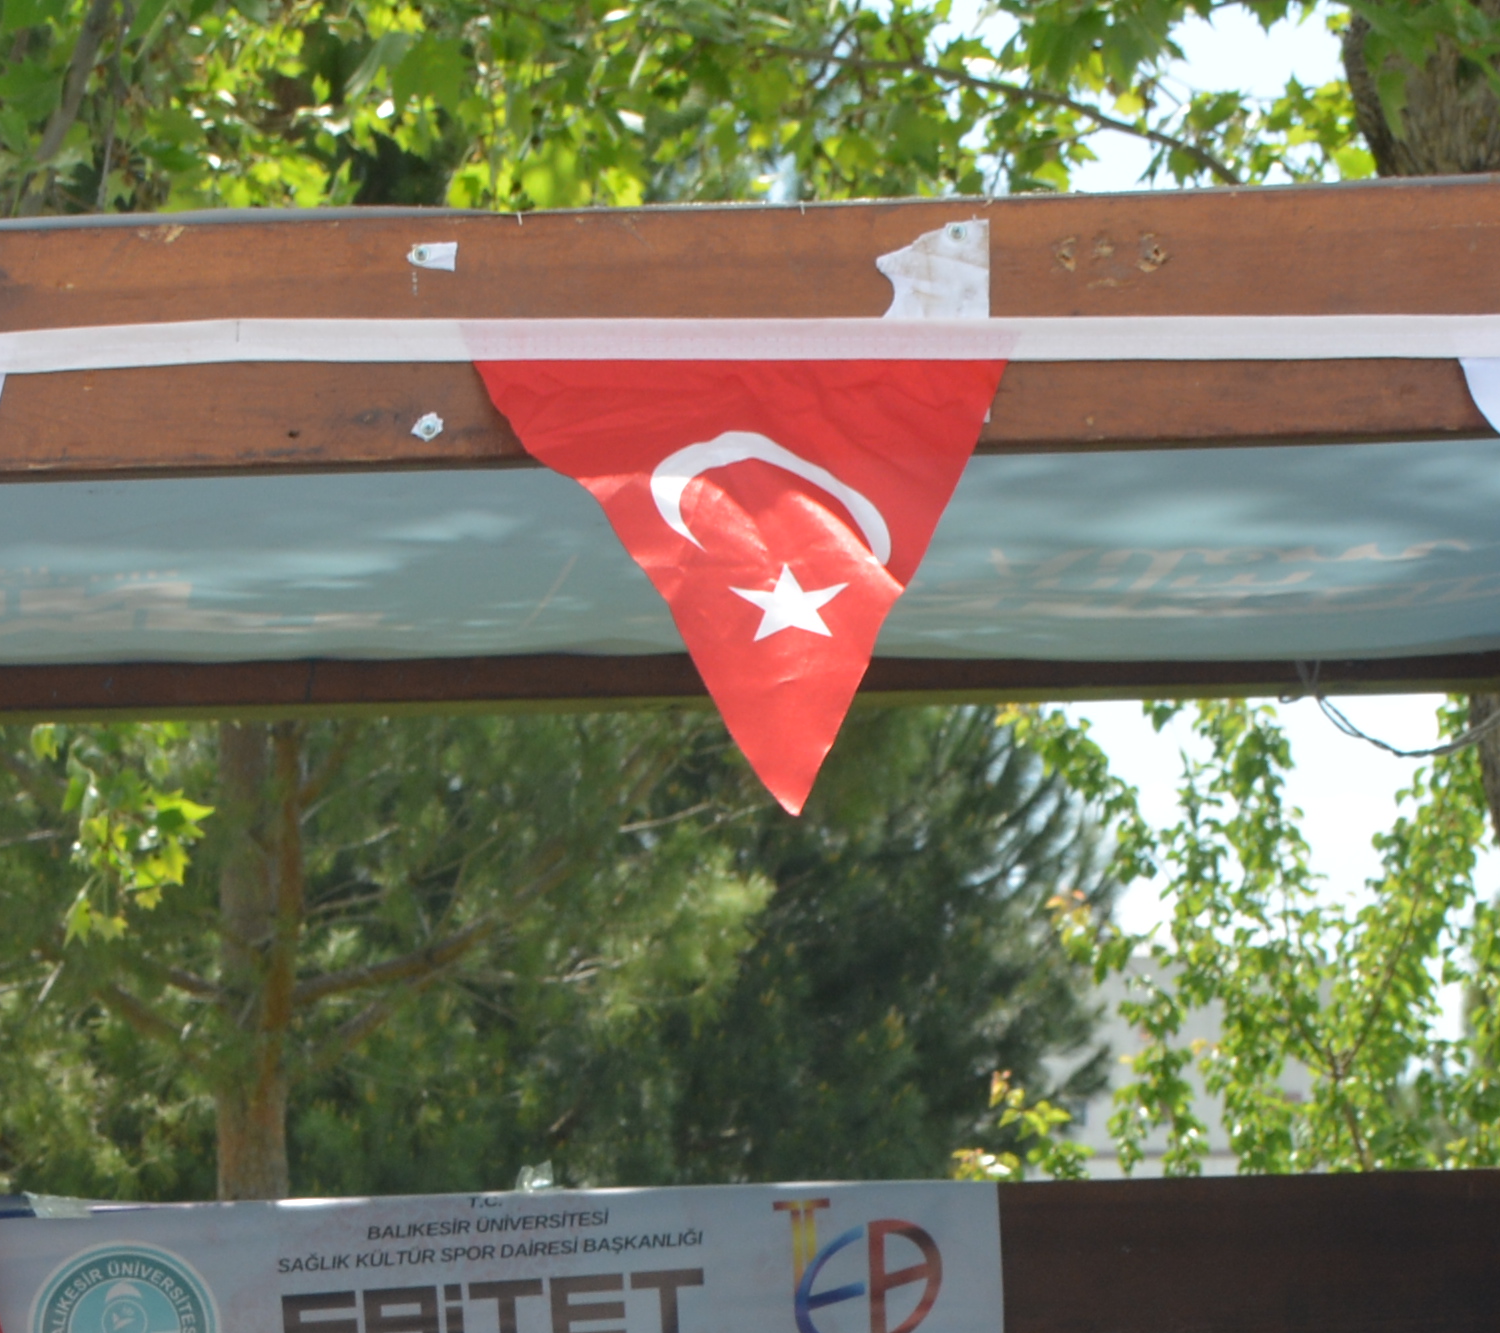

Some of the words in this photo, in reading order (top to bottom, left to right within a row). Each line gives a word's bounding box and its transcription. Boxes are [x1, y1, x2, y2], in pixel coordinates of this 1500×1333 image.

[367, 1215, 471, 1241] BALIKESİR
[476, 1209, 610, 1235] ÜNİVERSİTESİ
[277, 1250, 351, 1274] SAĞLIK
[356, 1247, 436, 1269] KÜLTÜR
[440, 1243, 496, 1264] SPOR
[500, 1237, 578, 1260] DAİRESİ
[583, 1230, 704, 1256] BAŞKANLIĞI
